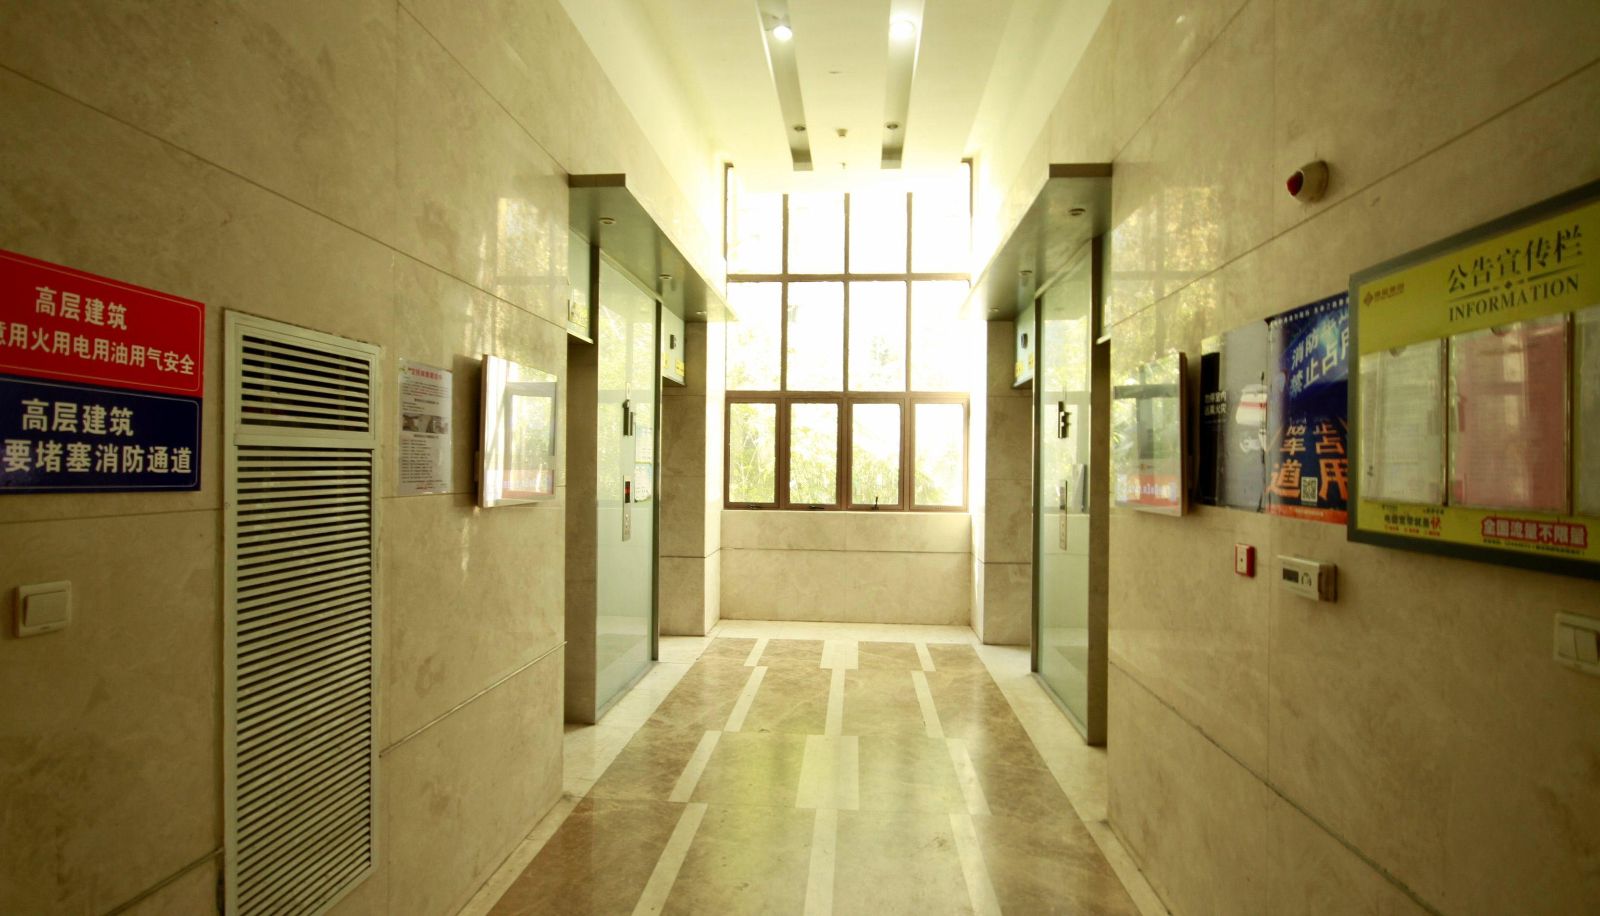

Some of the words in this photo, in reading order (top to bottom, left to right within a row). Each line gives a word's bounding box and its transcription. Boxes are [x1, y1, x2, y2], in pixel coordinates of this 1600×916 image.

[1448, 224, 1583, 293] 公告宣传栏
[35, 286, 128, 331] 高层建筑
[1449, 272, 1580, 321] INFORMATION
[21, 398, 134, 437] 高层建筑
[2, 439, 193, 474] 要堵塞消防通道
